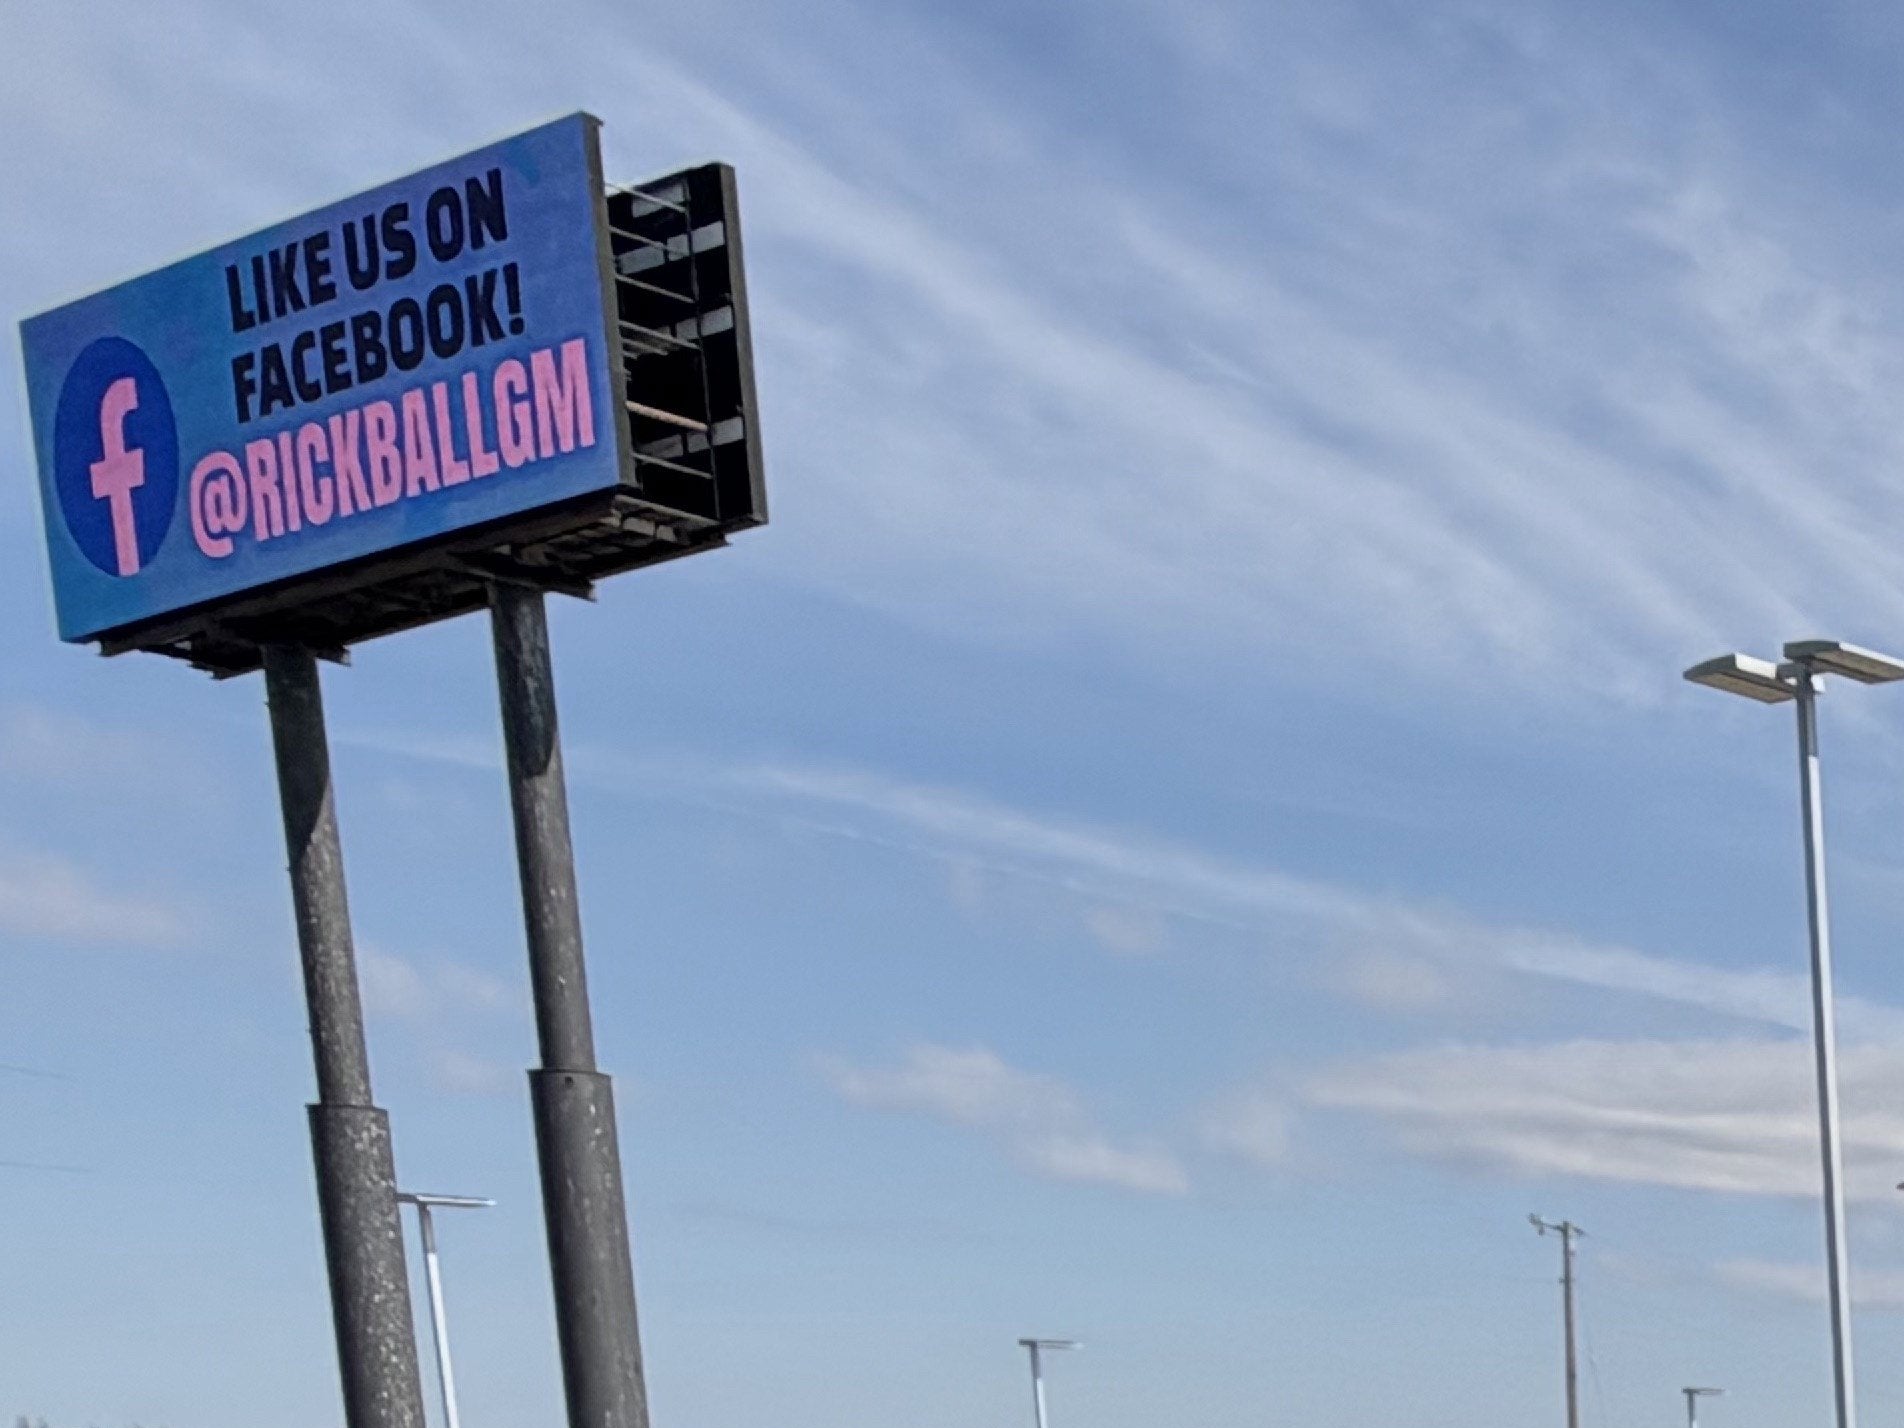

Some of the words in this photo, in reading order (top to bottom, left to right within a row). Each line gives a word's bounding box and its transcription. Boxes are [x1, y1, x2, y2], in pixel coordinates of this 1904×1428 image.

[226, 231, 337, 333] LIKE
[342, 202, 417, 291] US
[426, 168, 508, 263] ON
[231, 262, 524, 424] FACEBOOK!
[189, 338, 595, 559] @RICKBALLGM
